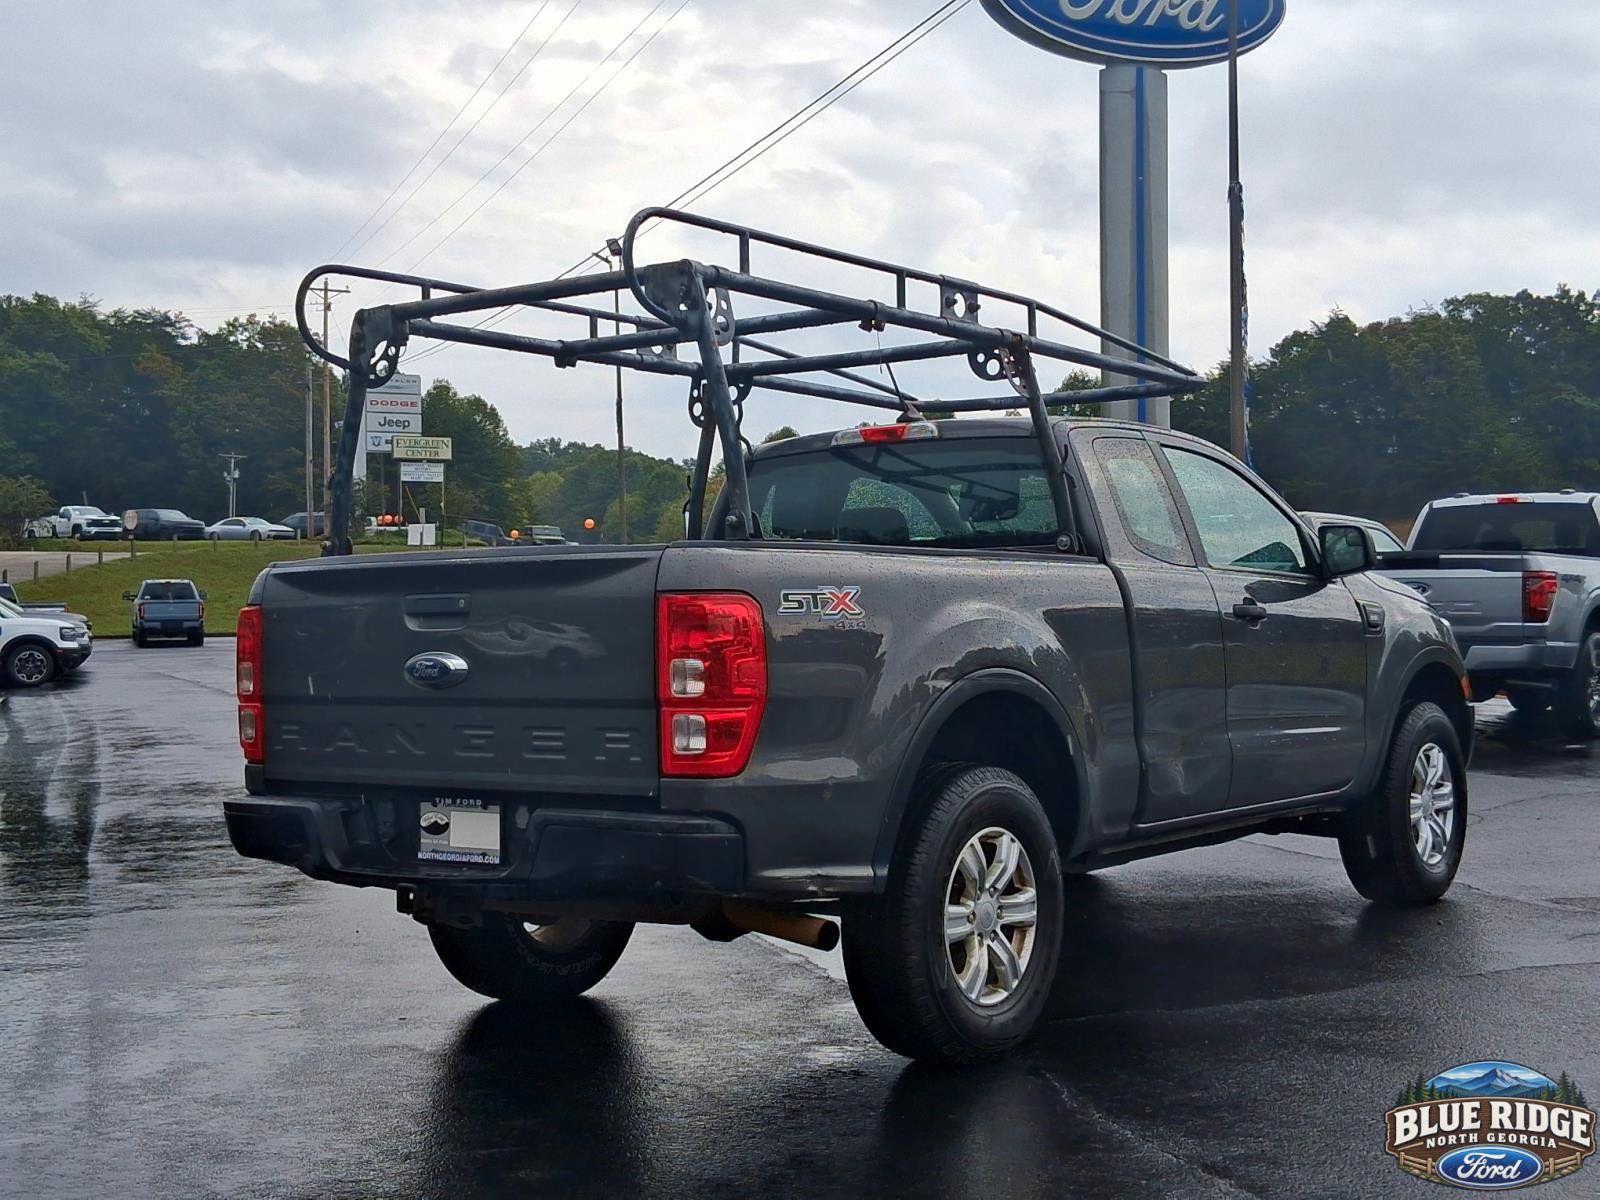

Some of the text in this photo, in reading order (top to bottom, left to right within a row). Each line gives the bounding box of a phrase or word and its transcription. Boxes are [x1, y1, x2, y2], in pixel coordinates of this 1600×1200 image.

[378, 416, 410, 429] Jeep
[396, 438, 450, 448] EVERGREEN
[405, 449, 440, 457] CENTER
[777, 585, 866, 620] STX
[413, 660, 441, 678] Ford
[272, 720, 643, 762] RANGER
